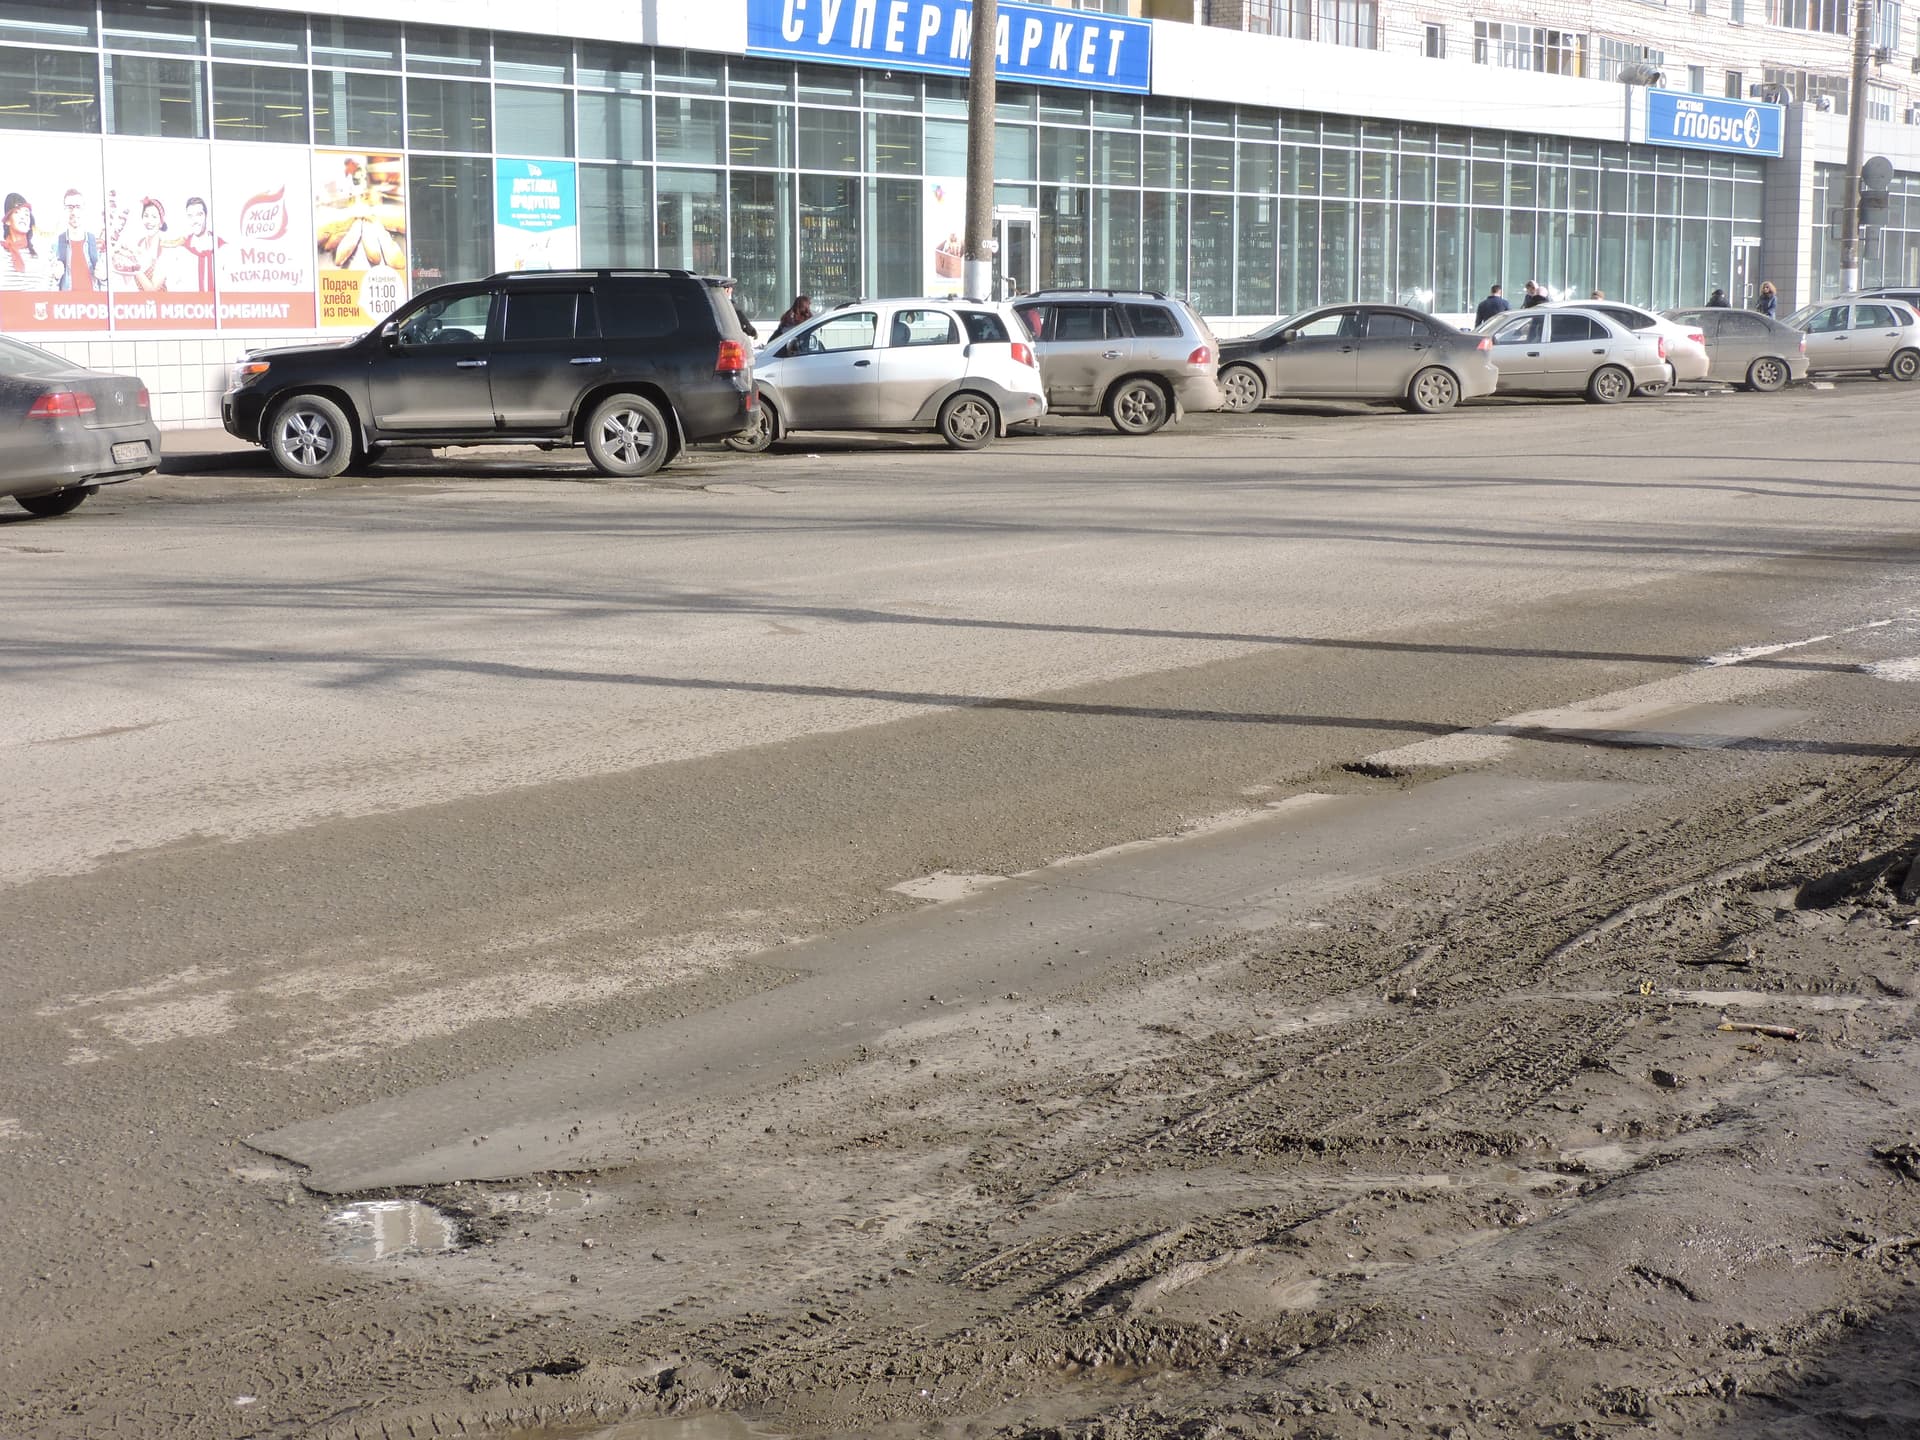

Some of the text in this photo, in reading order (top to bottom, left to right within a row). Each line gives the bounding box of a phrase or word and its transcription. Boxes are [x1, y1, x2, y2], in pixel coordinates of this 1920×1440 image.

[780, 0, 1125, 77] СУПЕРМАРКЕТ
[1673, 111, 1744, 142] ГЛОБУС
[322, 277, 358, 292] Подача
[369, 284, 396, 298] 11:00
[323, 291, 352, 305] хлеба
[53, 300, 290, 320] КИРОВСКИЙ МЯСОКОМБИНАТ
[323, 307, 360, 318] из печи
[369, 300, 396, 313] 16:00
